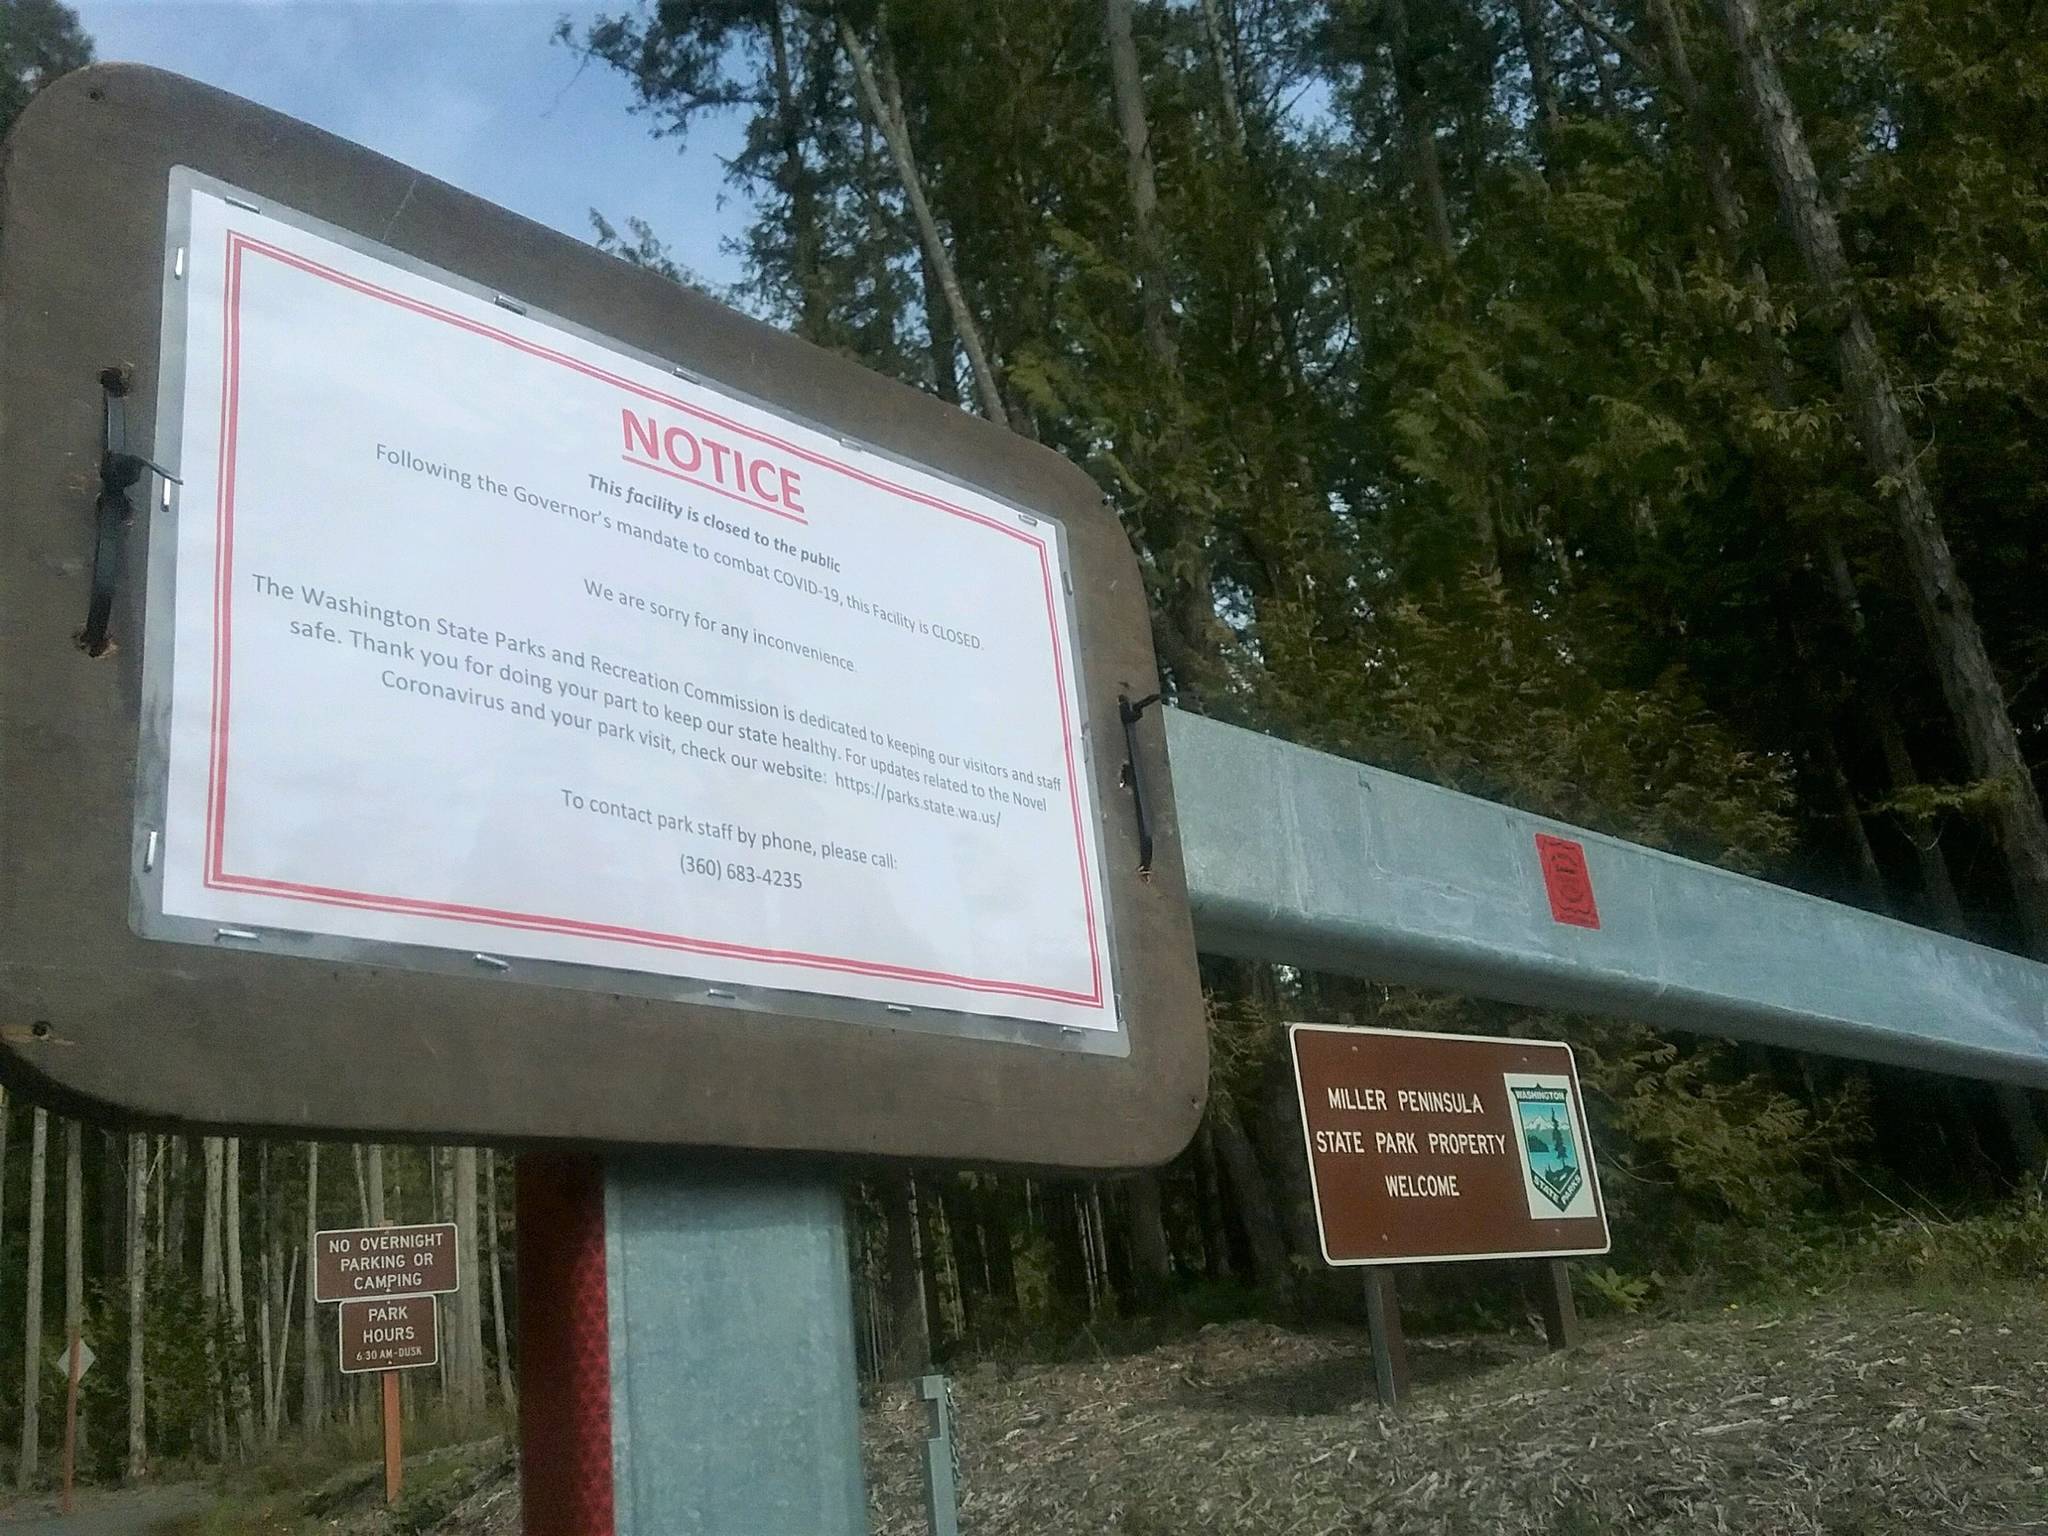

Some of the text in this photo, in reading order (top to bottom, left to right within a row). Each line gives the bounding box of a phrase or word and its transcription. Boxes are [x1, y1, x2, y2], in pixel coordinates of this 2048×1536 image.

[622, 409, 804, 513] NOTICE
[588, 474, 841, 573] This facility is closed to the public
[376, 443, 472, 489] Following
[477, 475, 508, 496] the
[617, 519, 688, 553] mandate
[693, 543, 709, 559] to
[713, 551, 770, 580] combat
[774, 568, 844, 607] COVID-19,
[846, 595, 870, 614] this
[873, 604, 915, 632] Facility
[919, 622, 929, 635] is
[932, 624, 984, 650] CLOSED.
[583, 578, 857, 672] We are sorry for any inconvenience.
[252, 574, 1061, 792] The Washington State Parks and Recreation Commission is dedicated to keeping our visitors and staff
[290, 620, 1047, 812] safe. Thank you for doing your part to keep our state healthy. For updates related to the Novel
[382, 670, 1001, 827] Coronavirus and your park visit, check our website: https://parks.state.wa.us/
[561, 788, 897, 869] To contact park staff by phone, please call:
[680, 854, 802, 889] (360) 683-4235
[1327, 1087, 1484, 1114] MILLER PENINSULA
[1515, 1090, 1564, 1100] WASHINGTON
[1316, 1131, 1506, 1155] STATE PARK PROPERTY
[1385, 1175, 1460, 1197] WELCOME
[1534, 1174, 1581, 1205] STATE PARKS
[329, 1233, 443, 1253] NO OVERNIGHT
[341, 1252, 433, 1272] PARKING OR
[354, 1273, 422, 1290] CAMPING
[368, 1306, 408, 1322] PARK
[363, 1326, 414, 1344] HOURS
